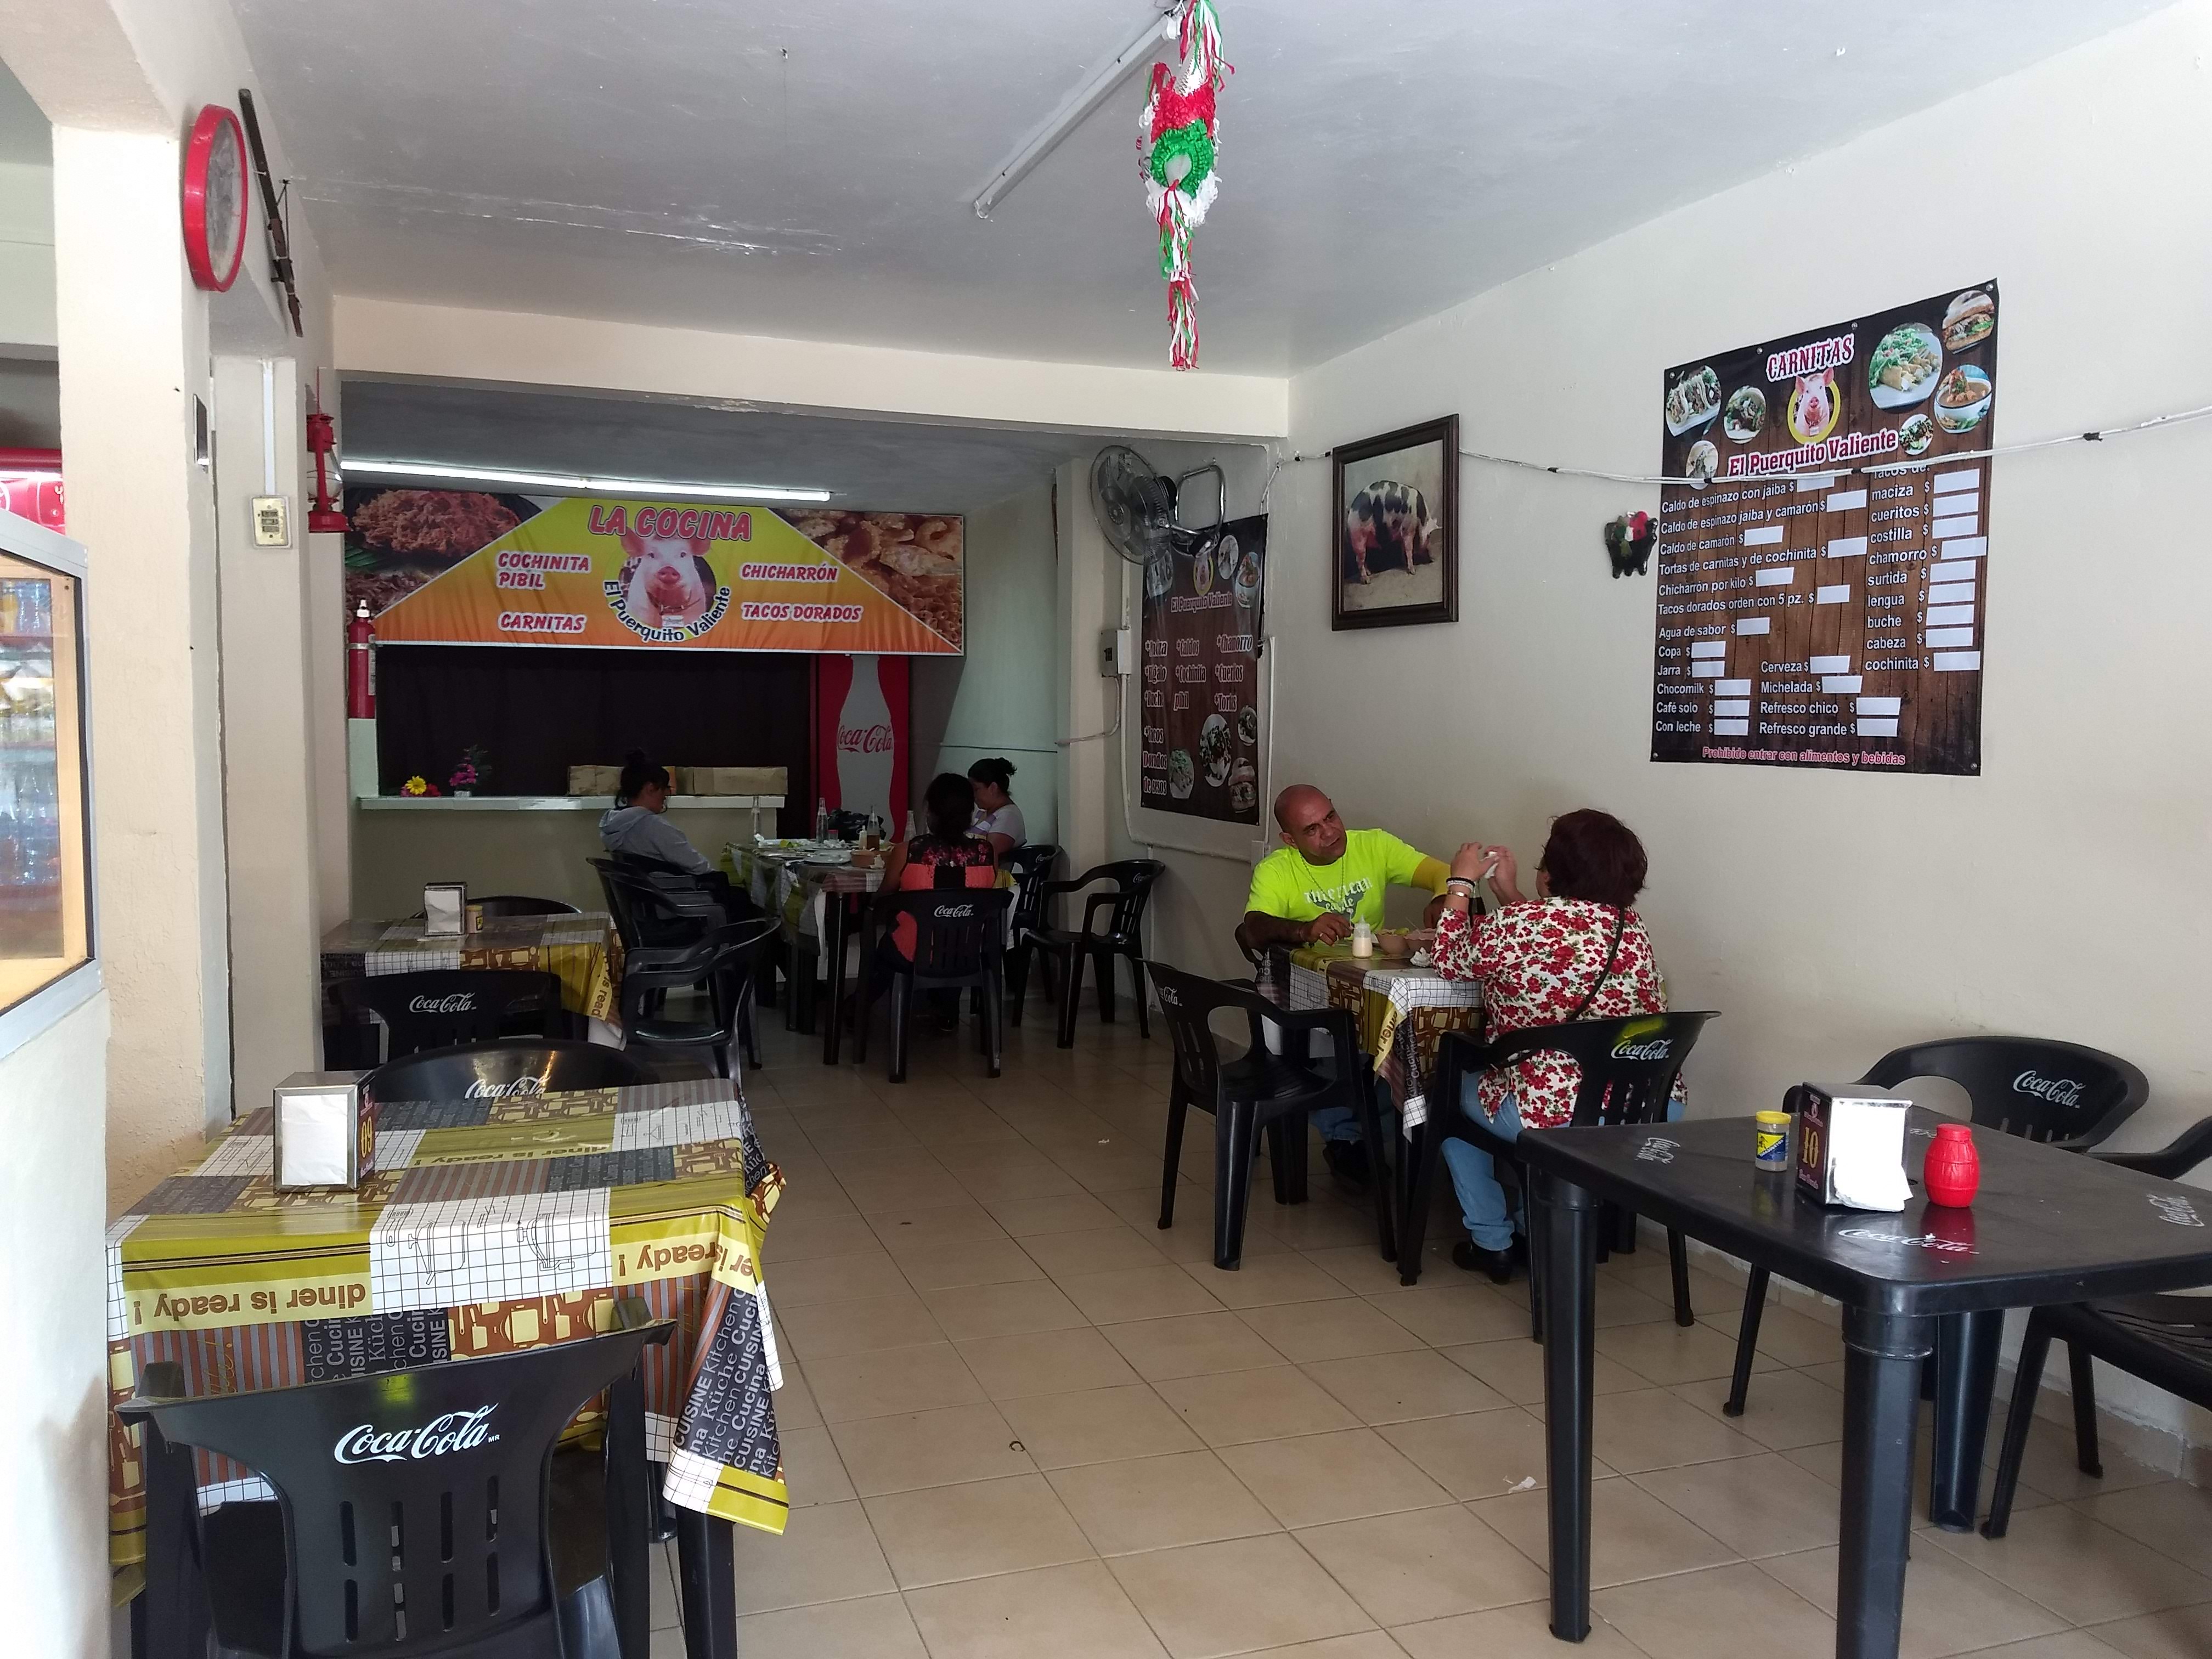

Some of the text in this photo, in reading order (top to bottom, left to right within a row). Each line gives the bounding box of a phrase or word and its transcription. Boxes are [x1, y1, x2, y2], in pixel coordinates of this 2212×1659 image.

[1767, 334, 1854, 381] CARNITAS
[1729, 428, 1898, 476] El Puerquito Valiente
[1662, 481, 1795, 514] Caldo de espinazo con jaiba $
[1872, 481, 1930, 500] maciza $
[588, 505, 752, 541] LA COCINA
[1661, 500, 1825, 534] Caldo de espinazo jaiba y camarón $
[1871, 504, 1929, 522] cueritos $
[1660, 533, 1744, 555] Caldo de camarón $
[1870, 524, 1928, 544] costilla $
[497, 551, 591, 573] COCHINITA
[1659, 546, 1826, 575] Tortas de carnitas y de cochinita $
[1869, 545, 1937, 565] chamorro $
[496, 570, 545, 590] PIBIL
[740, 562, 839, 583] CHICHARRÓN
[1867, 568, 1926, 586] surtida $
[1658, 576, 1753, 596] Chicharrón por kilo $
[1171, 597, 1178, 612] El
[1658, 592, 1814, 615] Tacos dorados orden con 5 pz. $
[1867, 590, 1925, 609] lengua $
[603, 580, 732, 642] El Puerquito Valiente
[742, 603, 864, 622] TACOS DORADOS
[1867, 611, 1923, 629] buche $
[498, 612, 586, 634] CARNITAS
[1658, 624, 1735, 640] Agua de sabor $
[1866, 633, 1923, 650] cabeza $
[1658, 646, 1690, 659] Copa $
[1657, 664, 1691, 676] Jarra $
[1761, 661, 1808, 673] Cerveza $
[1865, 656, 1929, 670] cochinita $
[1657, 682, 1714, 694] Chocomilk $
[1761, 681, 1821, 693] Michelada $
[1173, 691, 1189, 711] pibil
[1656, 702, 1713, 714] Café solo $
[1760, 701, 1854, 714] Refresco chico $
[1656, 721, 1713, 733] Con leche $
[1759, 722, 1855, 737] Refresco grande $
[838, 725, 893, 753] Coca-Cola
[1702, 746, 1905, 766] Prohibido entrar con alimentos y bebidas
[1143, 776, 1167, 795] de sesos
[934, 904, 974, 917] Coca-Cola
[409, 992, 475, 1013] Coca-Cola
[591, 990, 607, 1018] read
[1611, 1039, 1673, 1060] Coca-Cola
[2013, 1070, 2086, 1107] Coca-Cola
[361, 1116, 372, 1158] 09
[1802, 1127, 1819, 1169] 10
[432, 1154, 503, 1164] ready
[637, 1242, 715, 1271] ready
[134, 1283, 365, 1325] diner is ready !
[674, 1376, 712, 1447] CUISINE
[702, 1302, 741, 1373] Kitchen
[700, 1353, 737, 1421] Küche
[731, 1364, 765, 1430] Cucina
[334, 1403, 500, 1464] Coca-Cola MR
[702, 1388, 741, 1459] Kitchen
[734, 1397, 769, 1468] CUISINE
